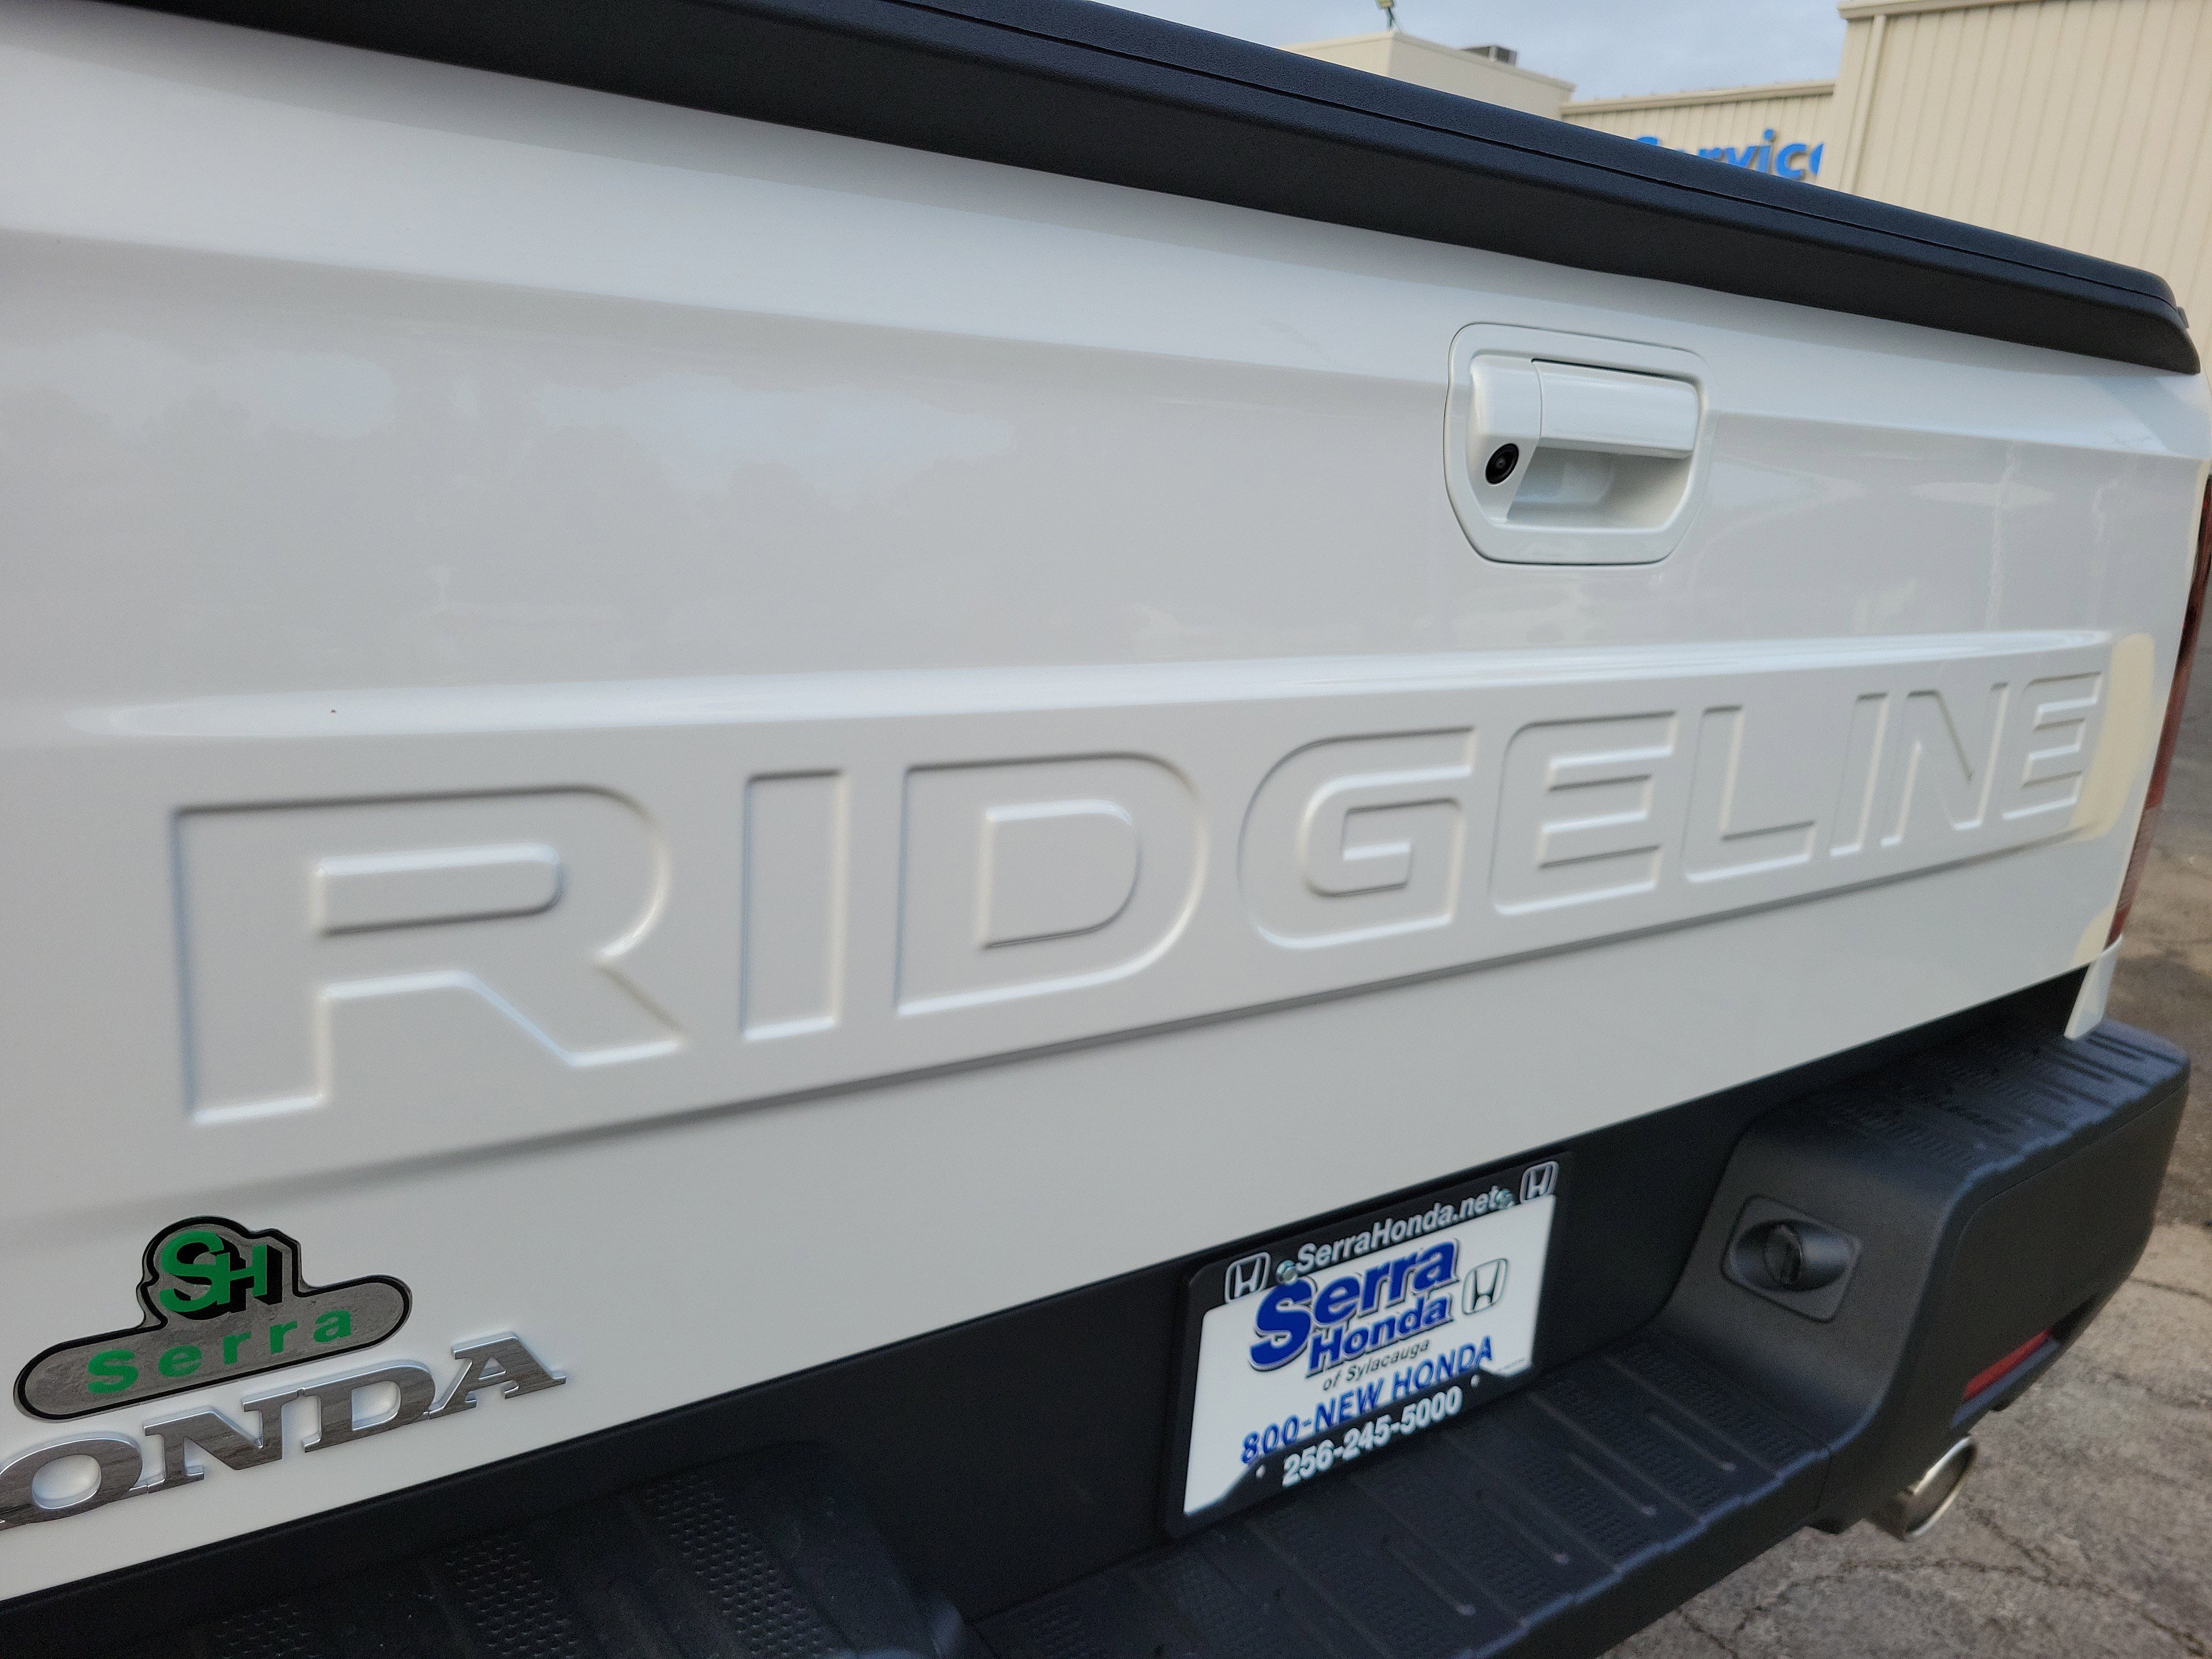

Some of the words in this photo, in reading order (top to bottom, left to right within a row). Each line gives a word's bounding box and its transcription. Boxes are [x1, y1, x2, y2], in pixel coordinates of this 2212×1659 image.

[169, 669, 2106, 1127] RIDGELINE
[157, 1229, 283, 1319] SH
[1295, 1185, 1502, 1272] SerraHonda.net
[87, 1309, 352, 1395] Serra
[1249, 1238, 1460, 1372] Serra
[1306, 1293, 1455, 1378] Honda
[1240, 1376, 1385, 1464] 800-NEW
[1391, 1335, 1493, 1402] HONDA
[1323, 1373, 1342, 1391] of
[1346, 1339, 1430, 1381] Sylacauga
[0, 1331, 567, 1530] ONDA
[1282, 1385, 1463, 1488] 256-245-5000
